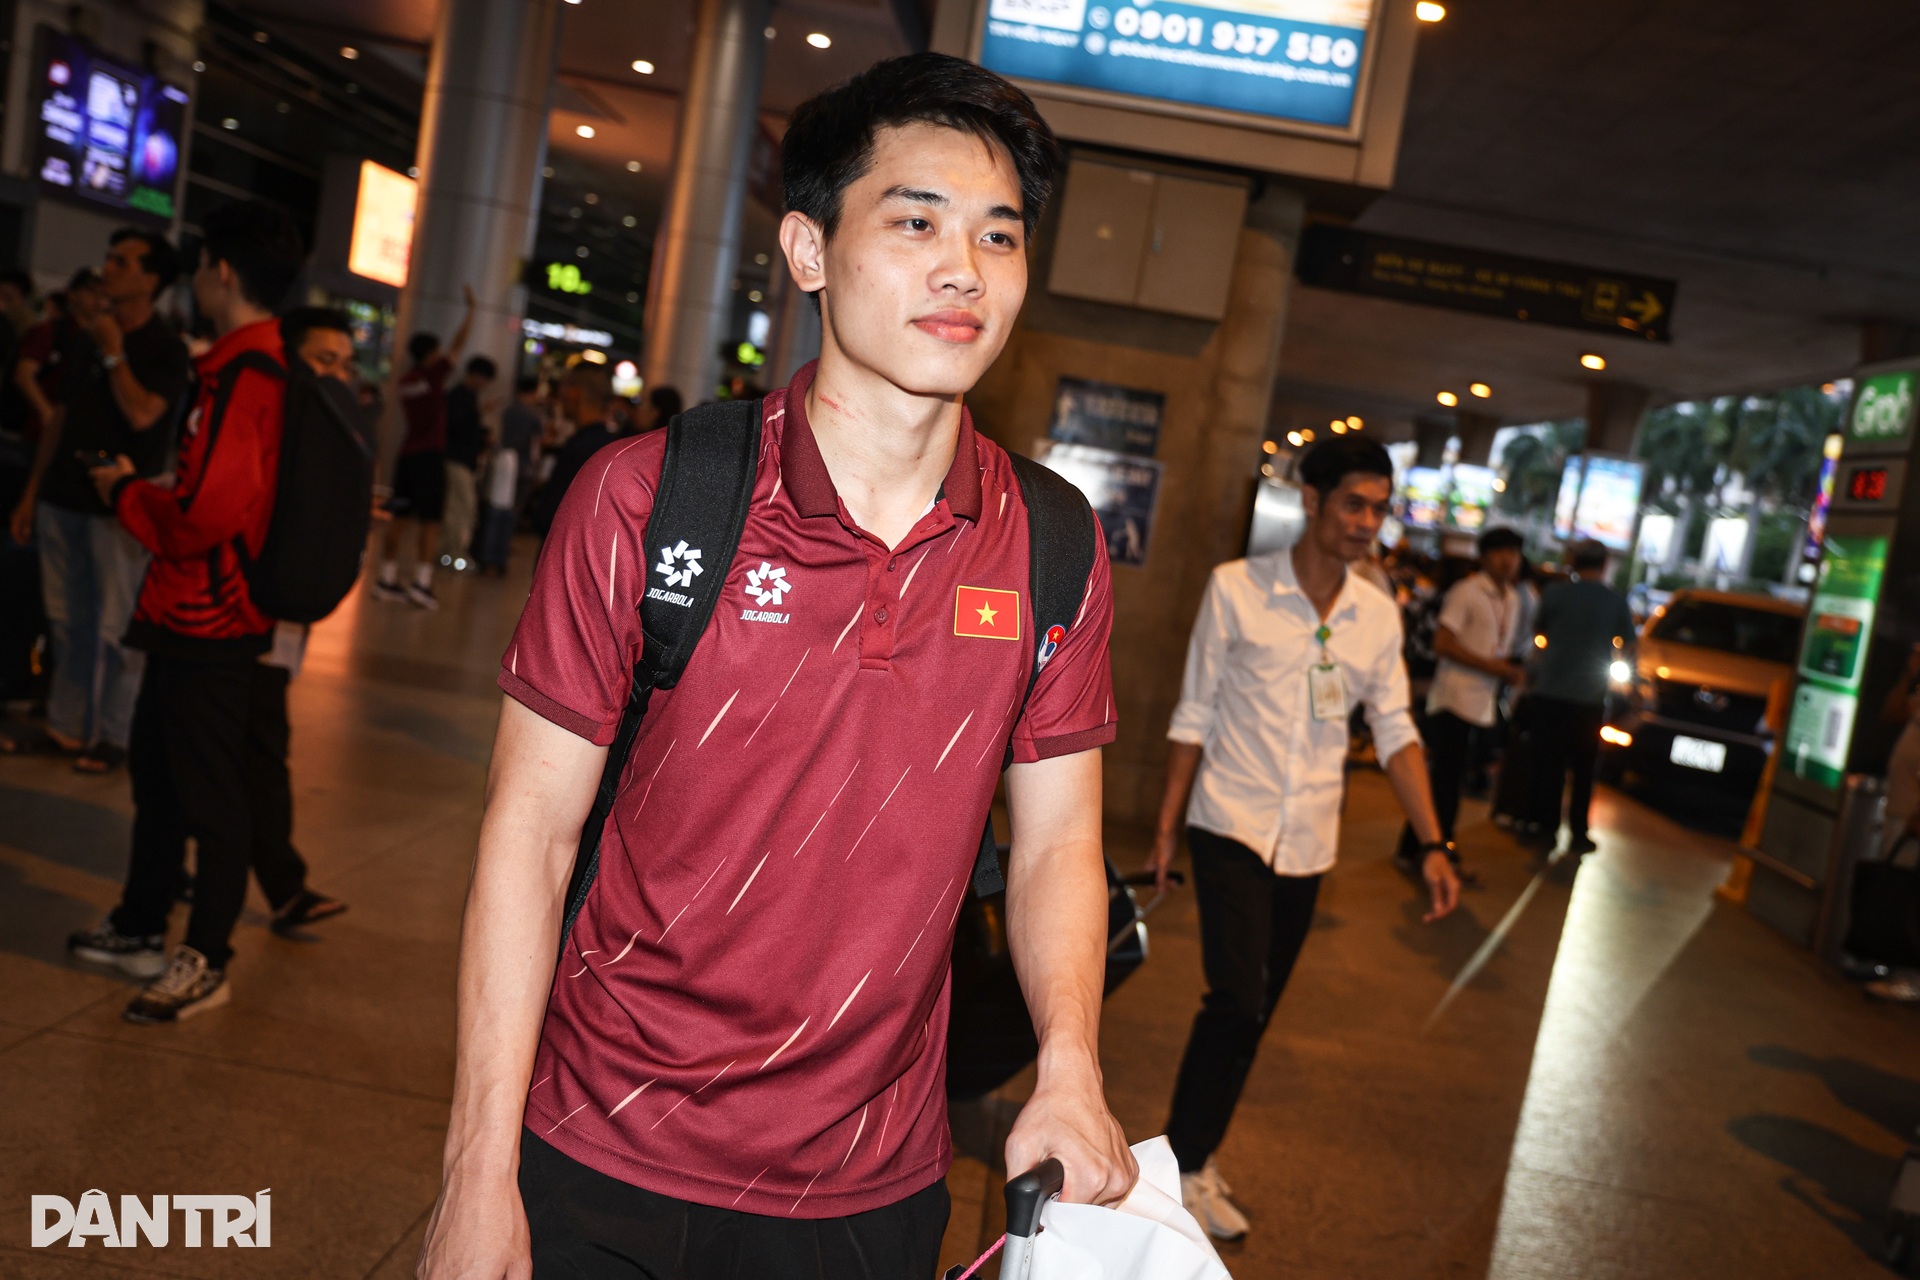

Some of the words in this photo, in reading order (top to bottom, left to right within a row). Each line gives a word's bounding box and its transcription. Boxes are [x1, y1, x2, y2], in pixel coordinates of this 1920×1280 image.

[1114, 7, 1203, 46] 0901
[1212, 20, 1279, 56] 937
[1286, 31, 1358, 68] 550
[1853, 378, 1911, 437] Grab
[647, 588, 694, 608] JOGARBOLA
[740, 609, 791, 624] JOGARBOLA
